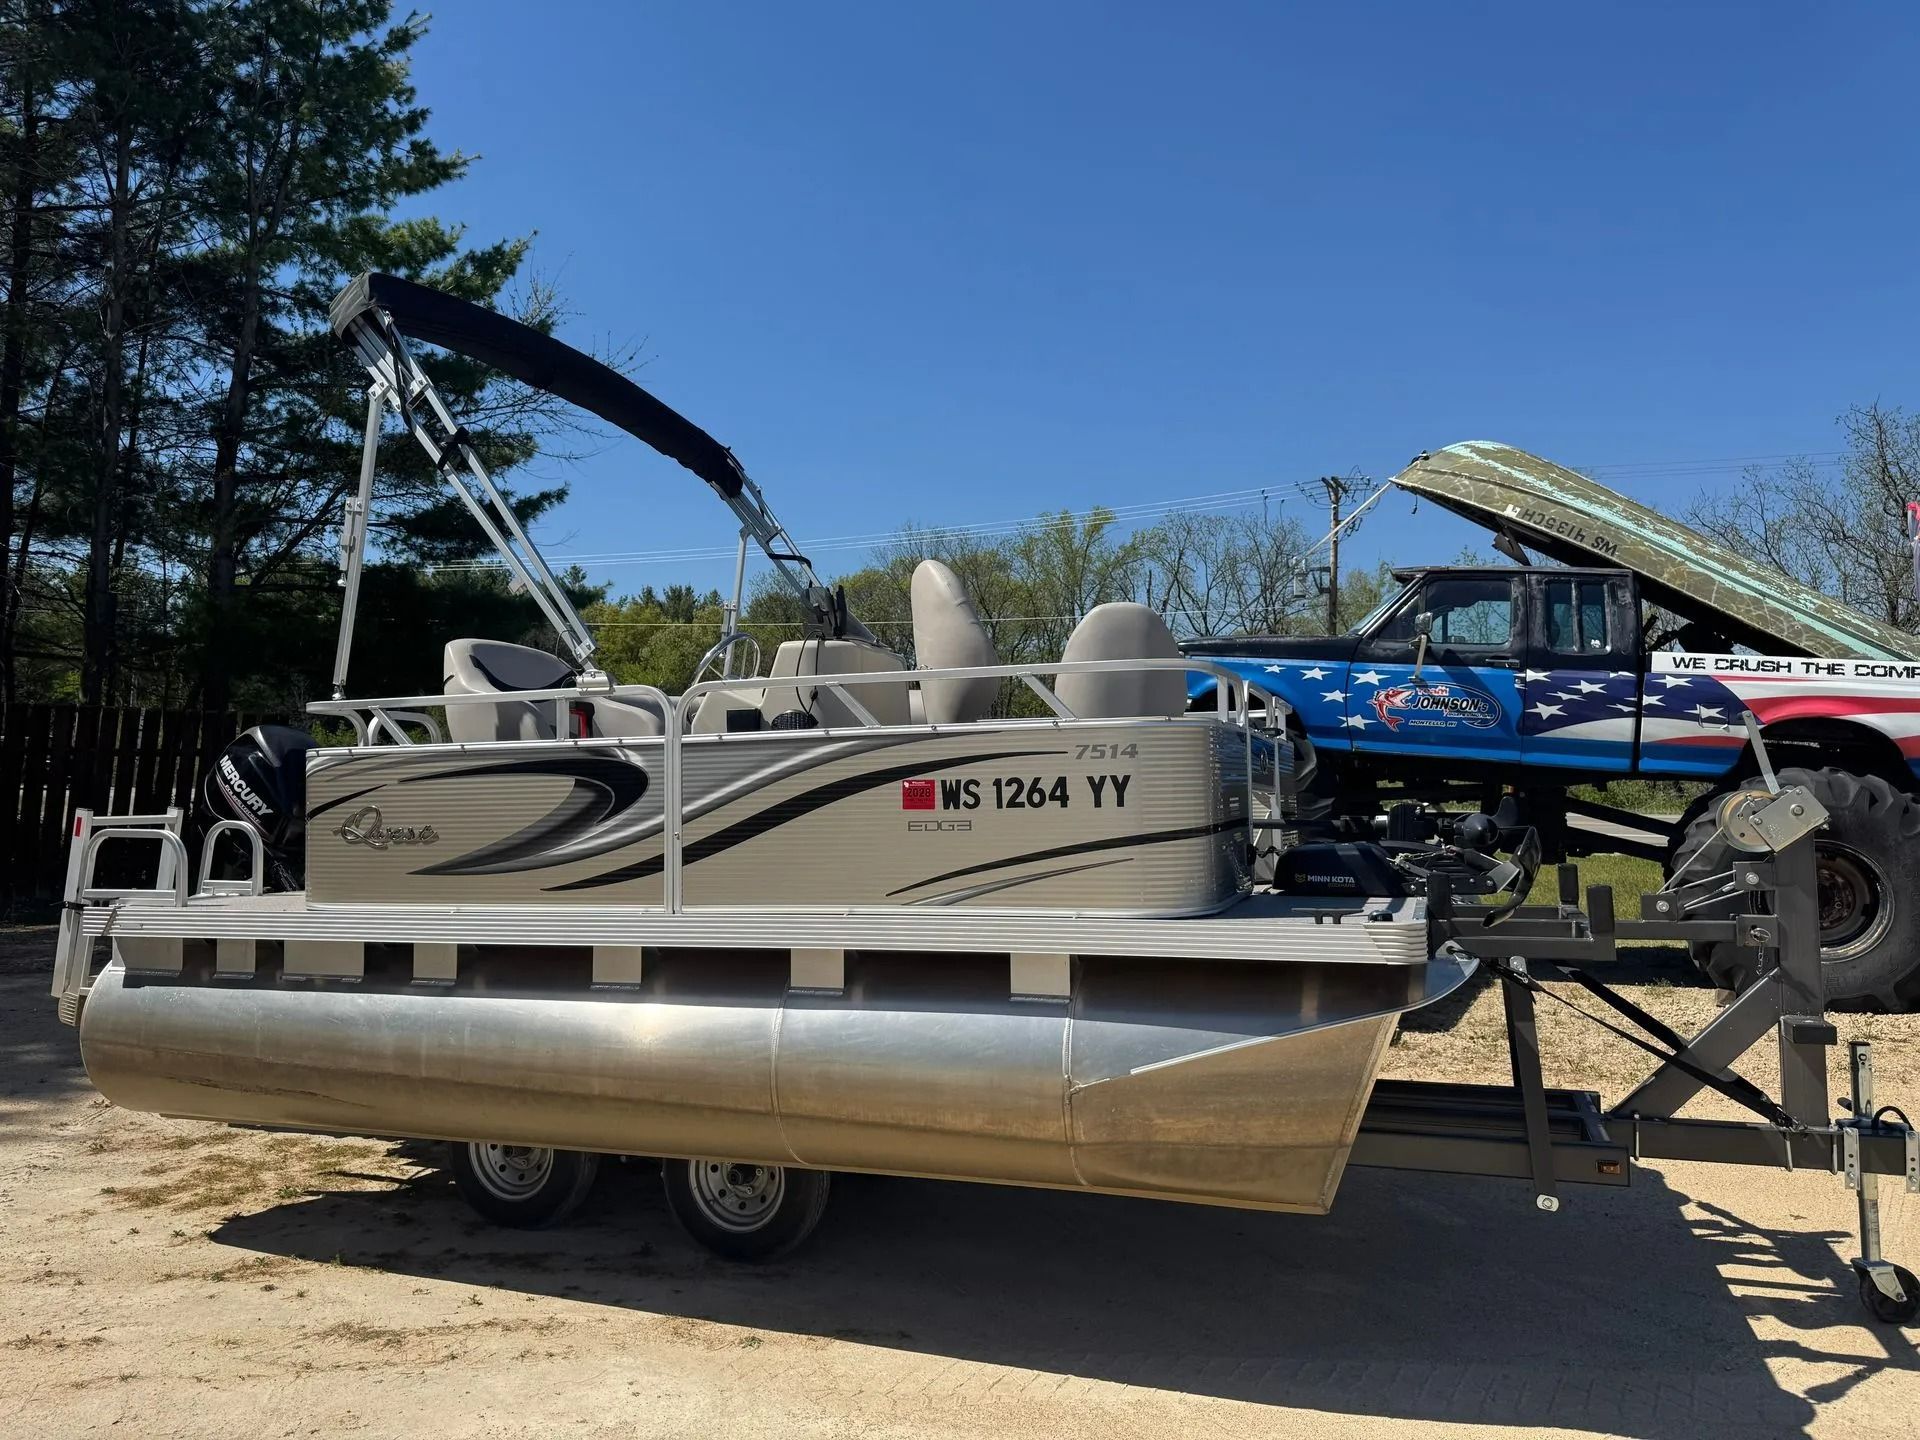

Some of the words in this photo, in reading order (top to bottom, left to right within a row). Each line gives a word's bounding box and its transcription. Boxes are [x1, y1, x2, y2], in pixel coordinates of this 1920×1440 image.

[1591, 536, 1618, 555] WS
[1672, 656, 1706, 670] WE
[1714, 658, 1792, 674] CRUSH
[1801, 661, 1845, 676] THE
[1075, 743, 1139, 760] 7514
[219, 755, 274, 817] MERCURY
[907, 788, 931, 798] 2028
[940, 778, 981, 810] WS
[992, 776, 1070, 809] 1264
[1086, 775, 1132, 808] YY
[908, 820, 972, 832] EDGE
